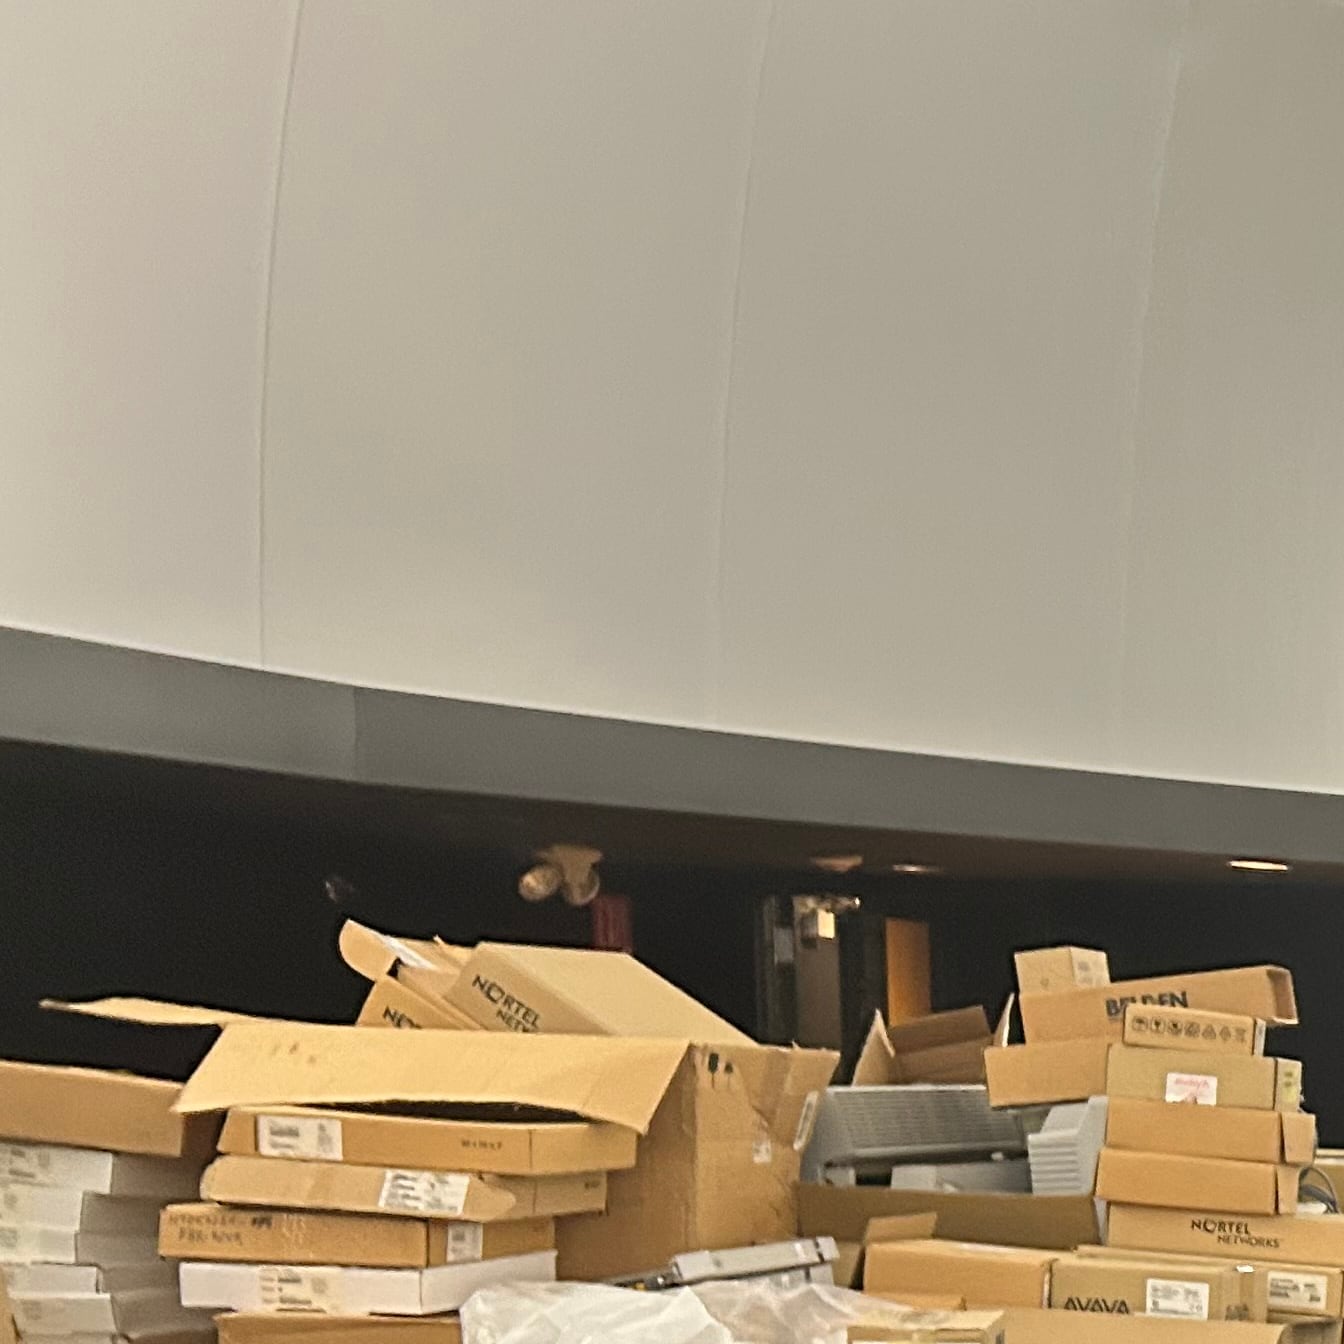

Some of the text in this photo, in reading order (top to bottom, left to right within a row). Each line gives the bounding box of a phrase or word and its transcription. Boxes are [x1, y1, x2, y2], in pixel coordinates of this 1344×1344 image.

[472, 975, 541, 1026] NORTEL
[1106, 991, 1189, 1018] BEDEN
[1190, 1218, 1251, 1235] NORTEL
[1216, 1233, 1281, 1248] NETWORKS
